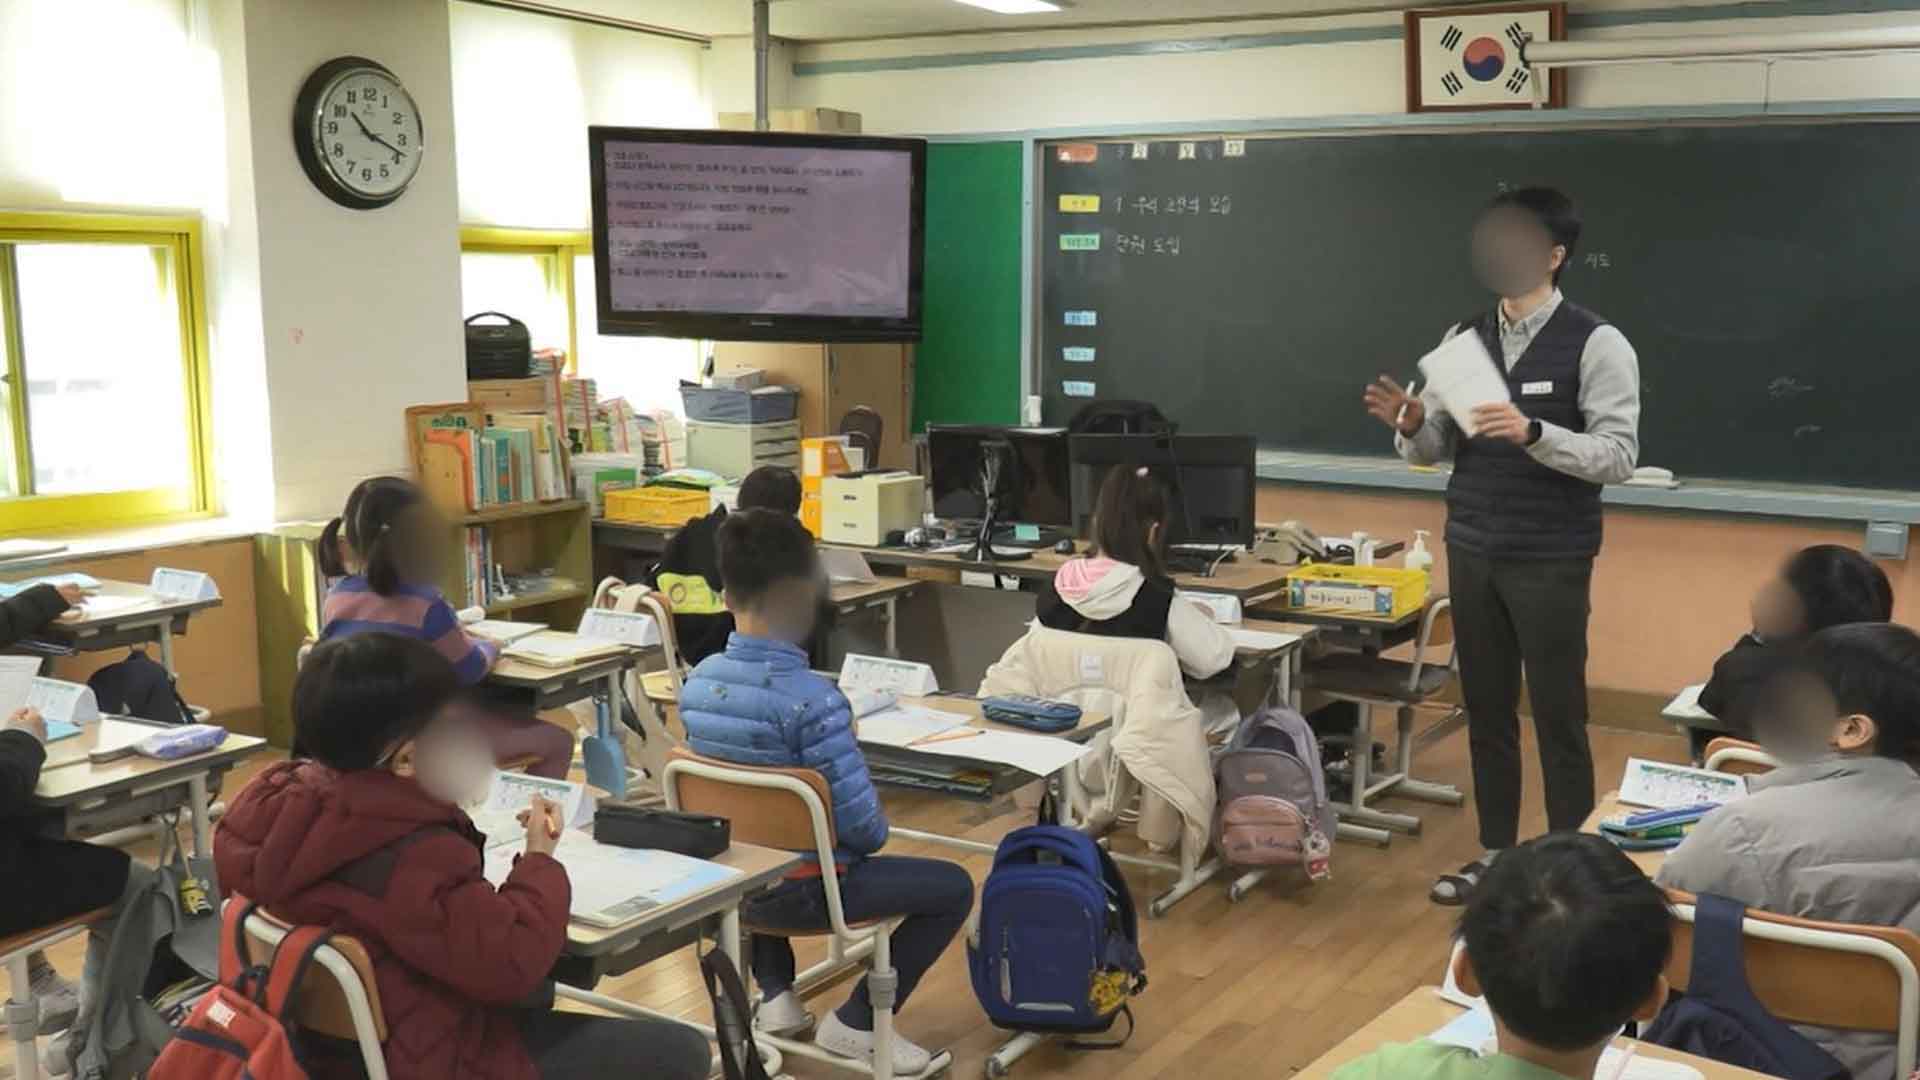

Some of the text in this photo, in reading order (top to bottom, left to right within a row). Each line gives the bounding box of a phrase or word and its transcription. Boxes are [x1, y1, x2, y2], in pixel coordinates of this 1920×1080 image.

[347, 90, 356, 104] 11
[363, 87, 377, 101] 12
[382, 95, 388, 108] 1
[334, 104, 347, 118] 10
[392, 112, 402, 124] 2
[328, 121, 338, 134] 9
[398, 134, 407, 146] 3
[334, 143, 344, 157] 8
[346, 160, 356, 174] 7
[379, 164, 389, 177] 5
[362, 168, 372, 181] 6
[1130, 196, 1158, 215] 우리
[1209, 195, 1231, 215] 모습
[1118, 233, 1145, 255] 단원
[1152, 235, 1179, 255] 도입
[1584, 253, 1611, 269] 지도
